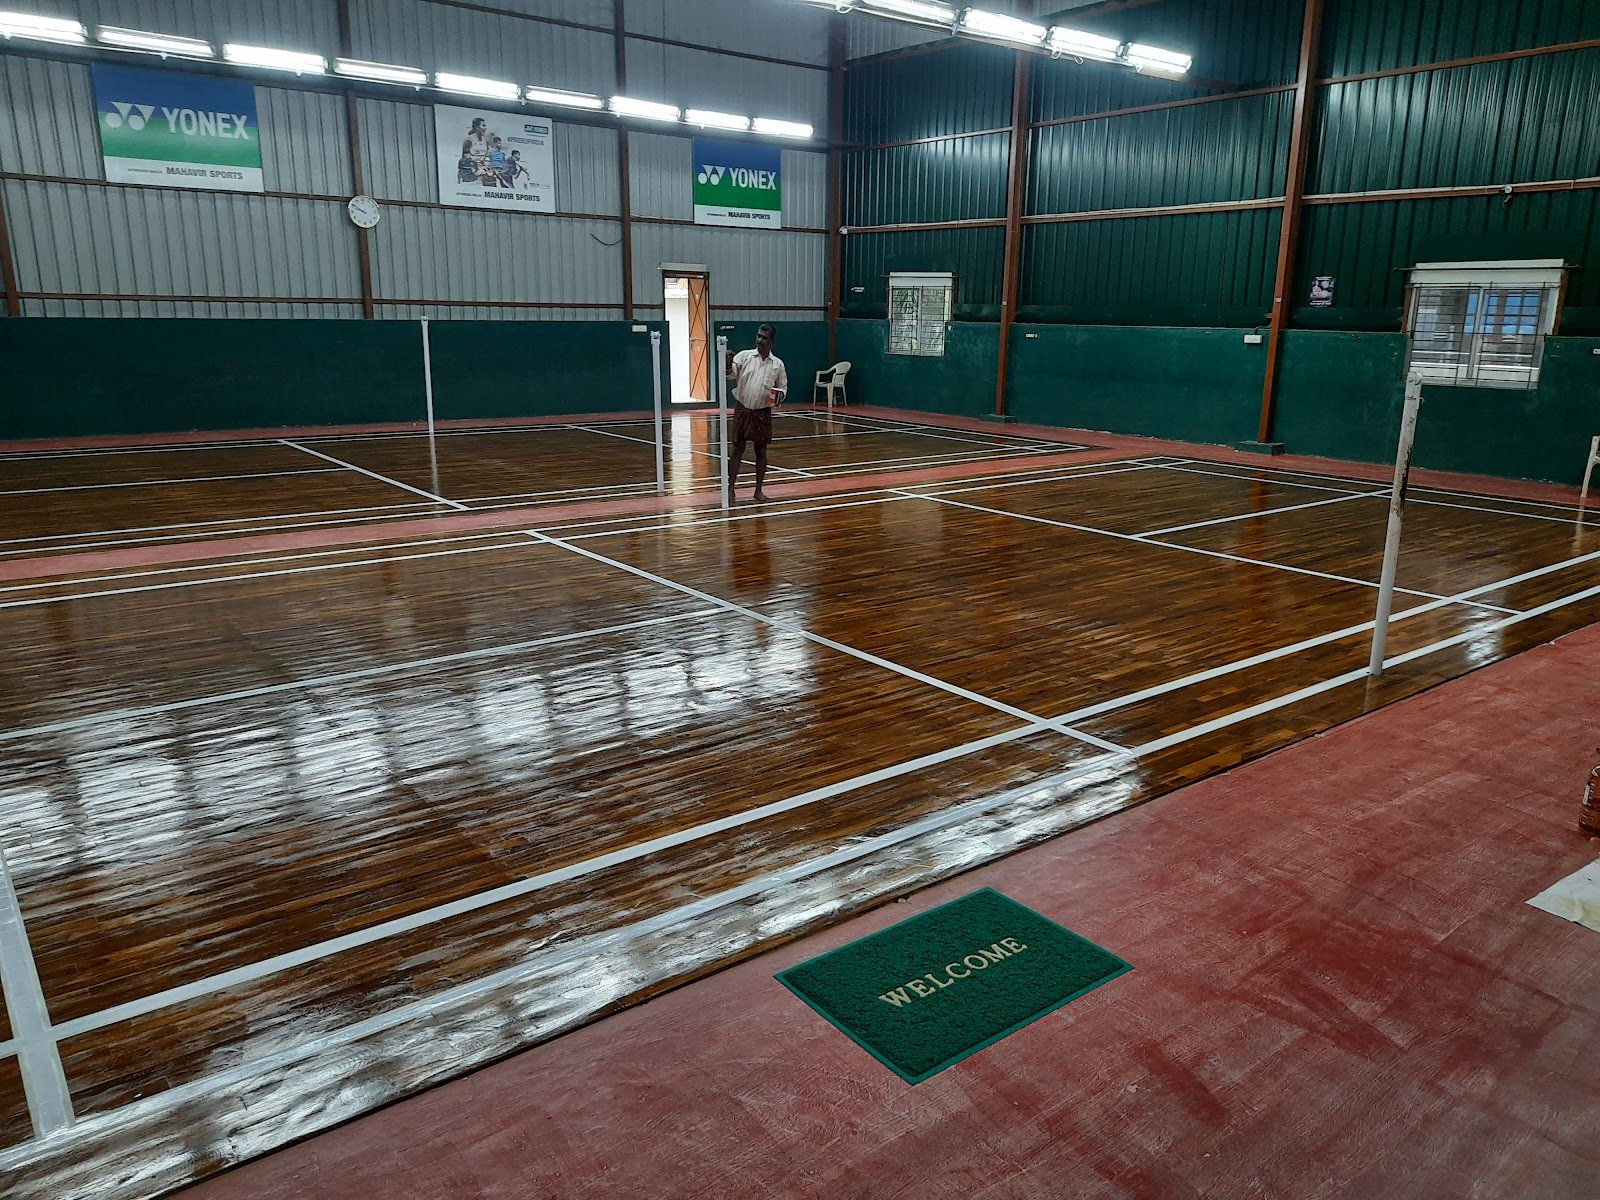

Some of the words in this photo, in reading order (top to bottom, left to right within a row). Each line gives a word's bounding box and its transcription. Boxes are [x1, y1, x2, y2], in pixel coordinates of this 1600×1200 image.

[161, 107, 249, 140] YONEX
[166, 166, 207, 177] MAHAVIR
[209, 171, 243, 180] SPORTS
[729, 168, 776, 190] YONEX
[484, 191, 514, 200] MAHAVIR
[515, 193, 540, 202] SPORTS
[877, 936, 1028, 1008] WELCOME
